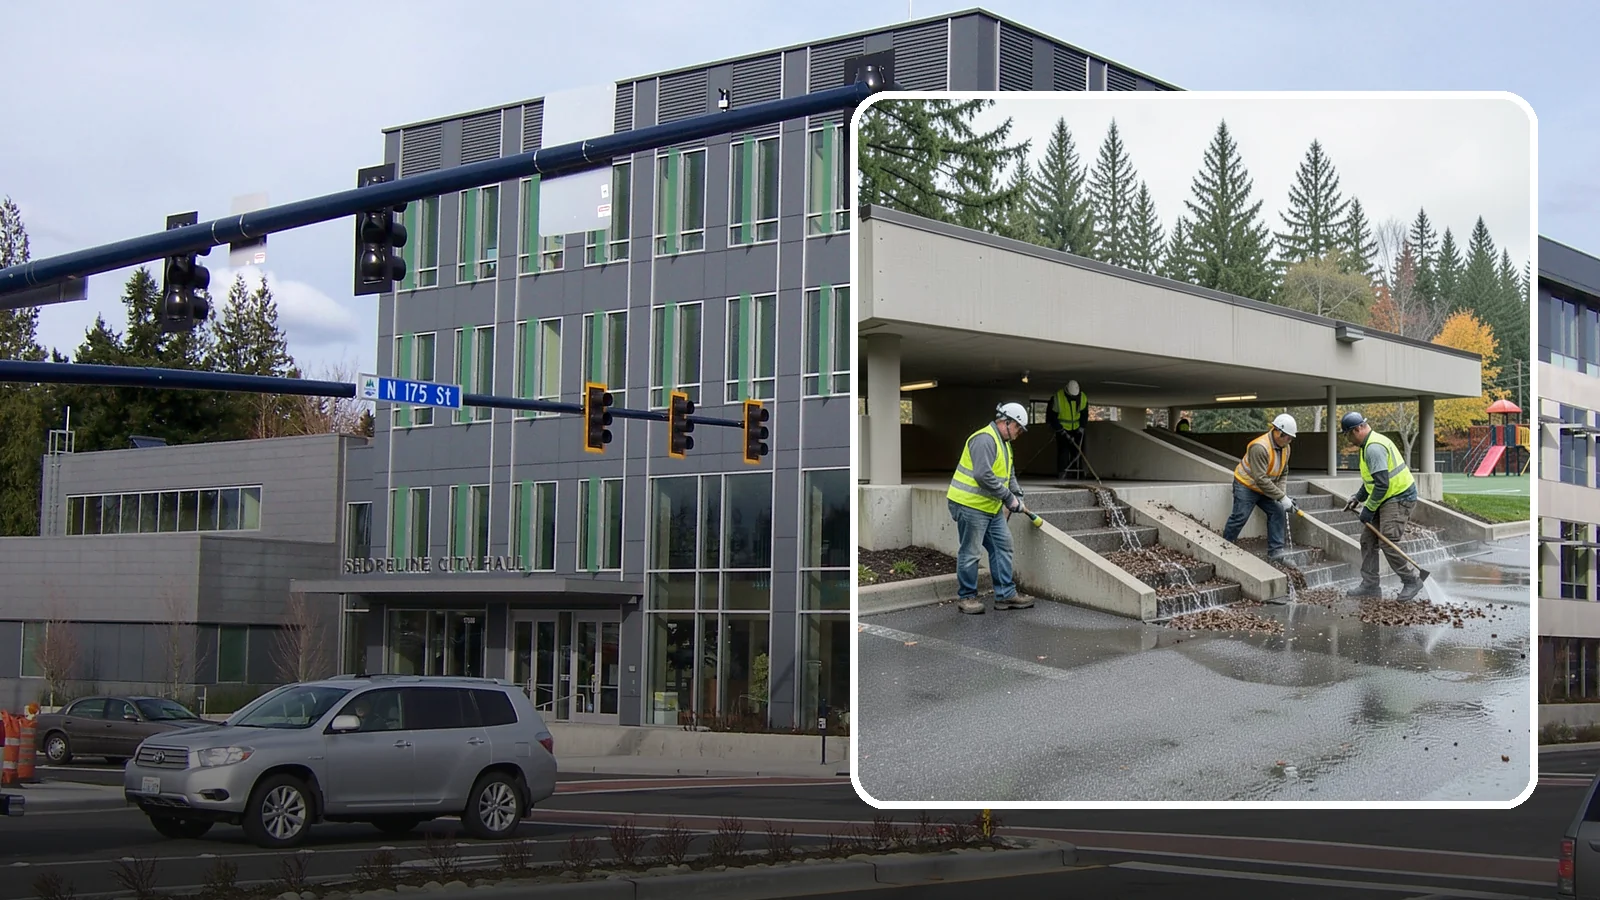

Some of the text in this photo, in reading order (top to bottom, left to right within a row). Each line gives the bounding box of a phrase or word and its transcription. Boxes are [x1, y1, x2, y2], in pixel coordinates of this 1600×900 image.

[387, 380, 451, 406] N 175 St
[344, 554, 525, 574] SHORELINE CITY HALL
